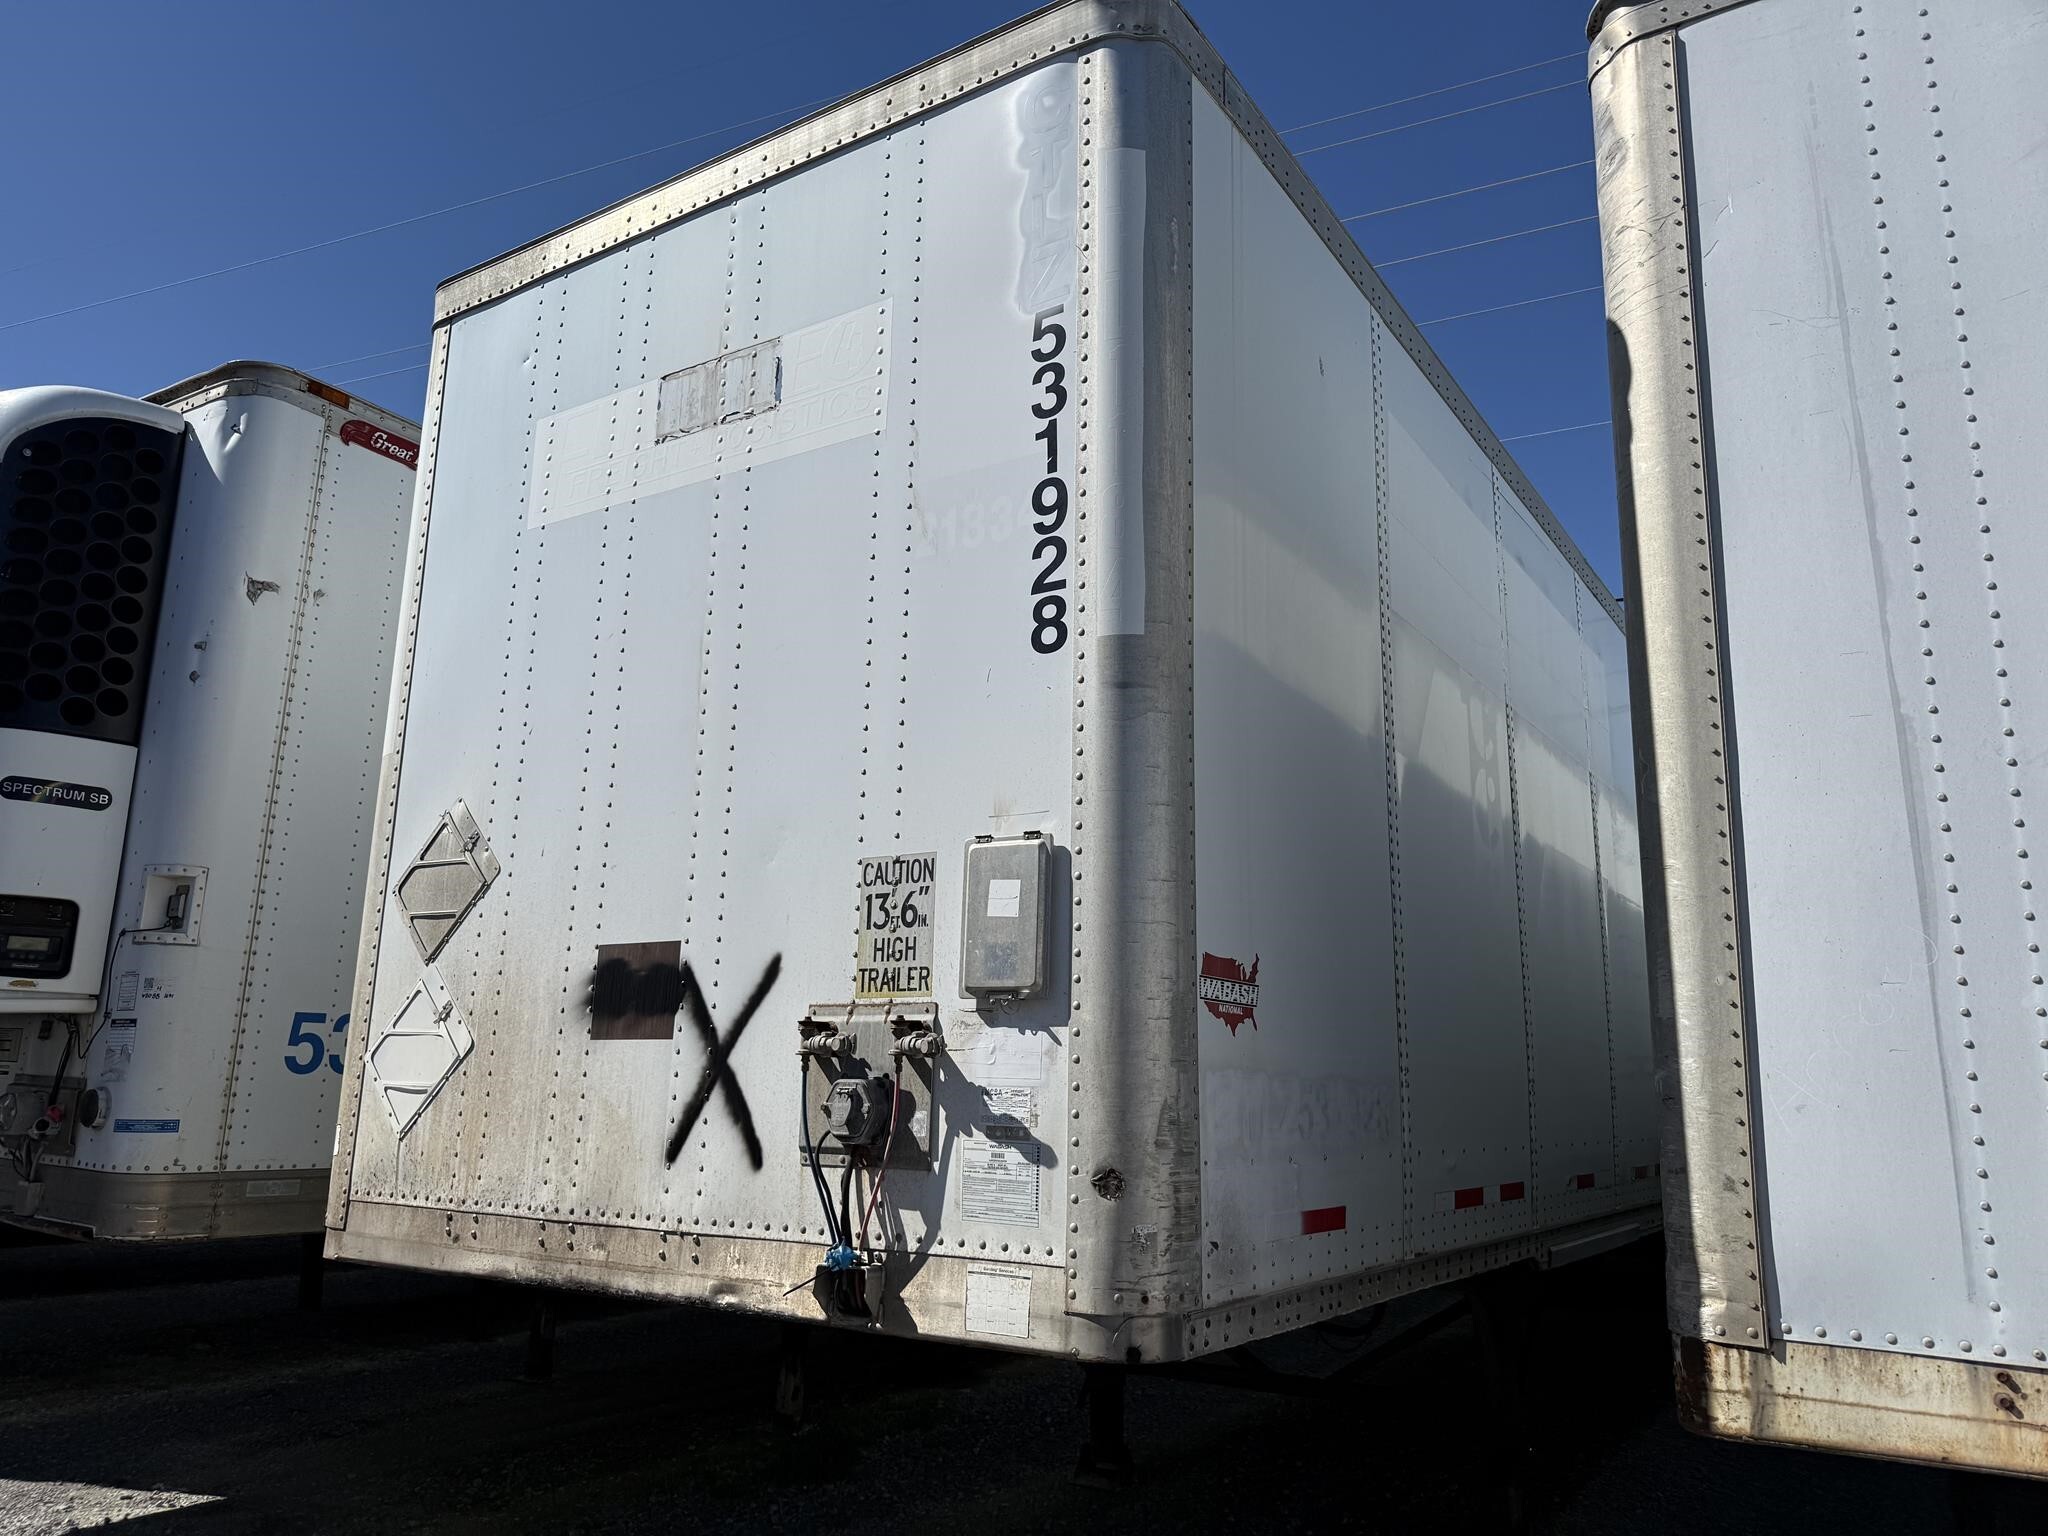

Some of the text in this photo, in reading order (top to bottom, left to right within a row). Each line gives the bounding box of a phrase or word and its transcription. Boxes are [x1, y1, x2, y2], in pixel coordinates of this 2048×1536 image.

[370, 431, 415, 462] Great
[1030, 303, 1069, 655] 531928
[2, 781, 109, 805] SPECTRUM SB
[863, 857, 935, 887] CAUTION
[873, 936, 917, 962] HIGH
[858, 966, 931, 993] TRAILER
[1200, 976, 1258, 1006] WABASH
[1218, 1003, 1244, 1015] NATIONAL
